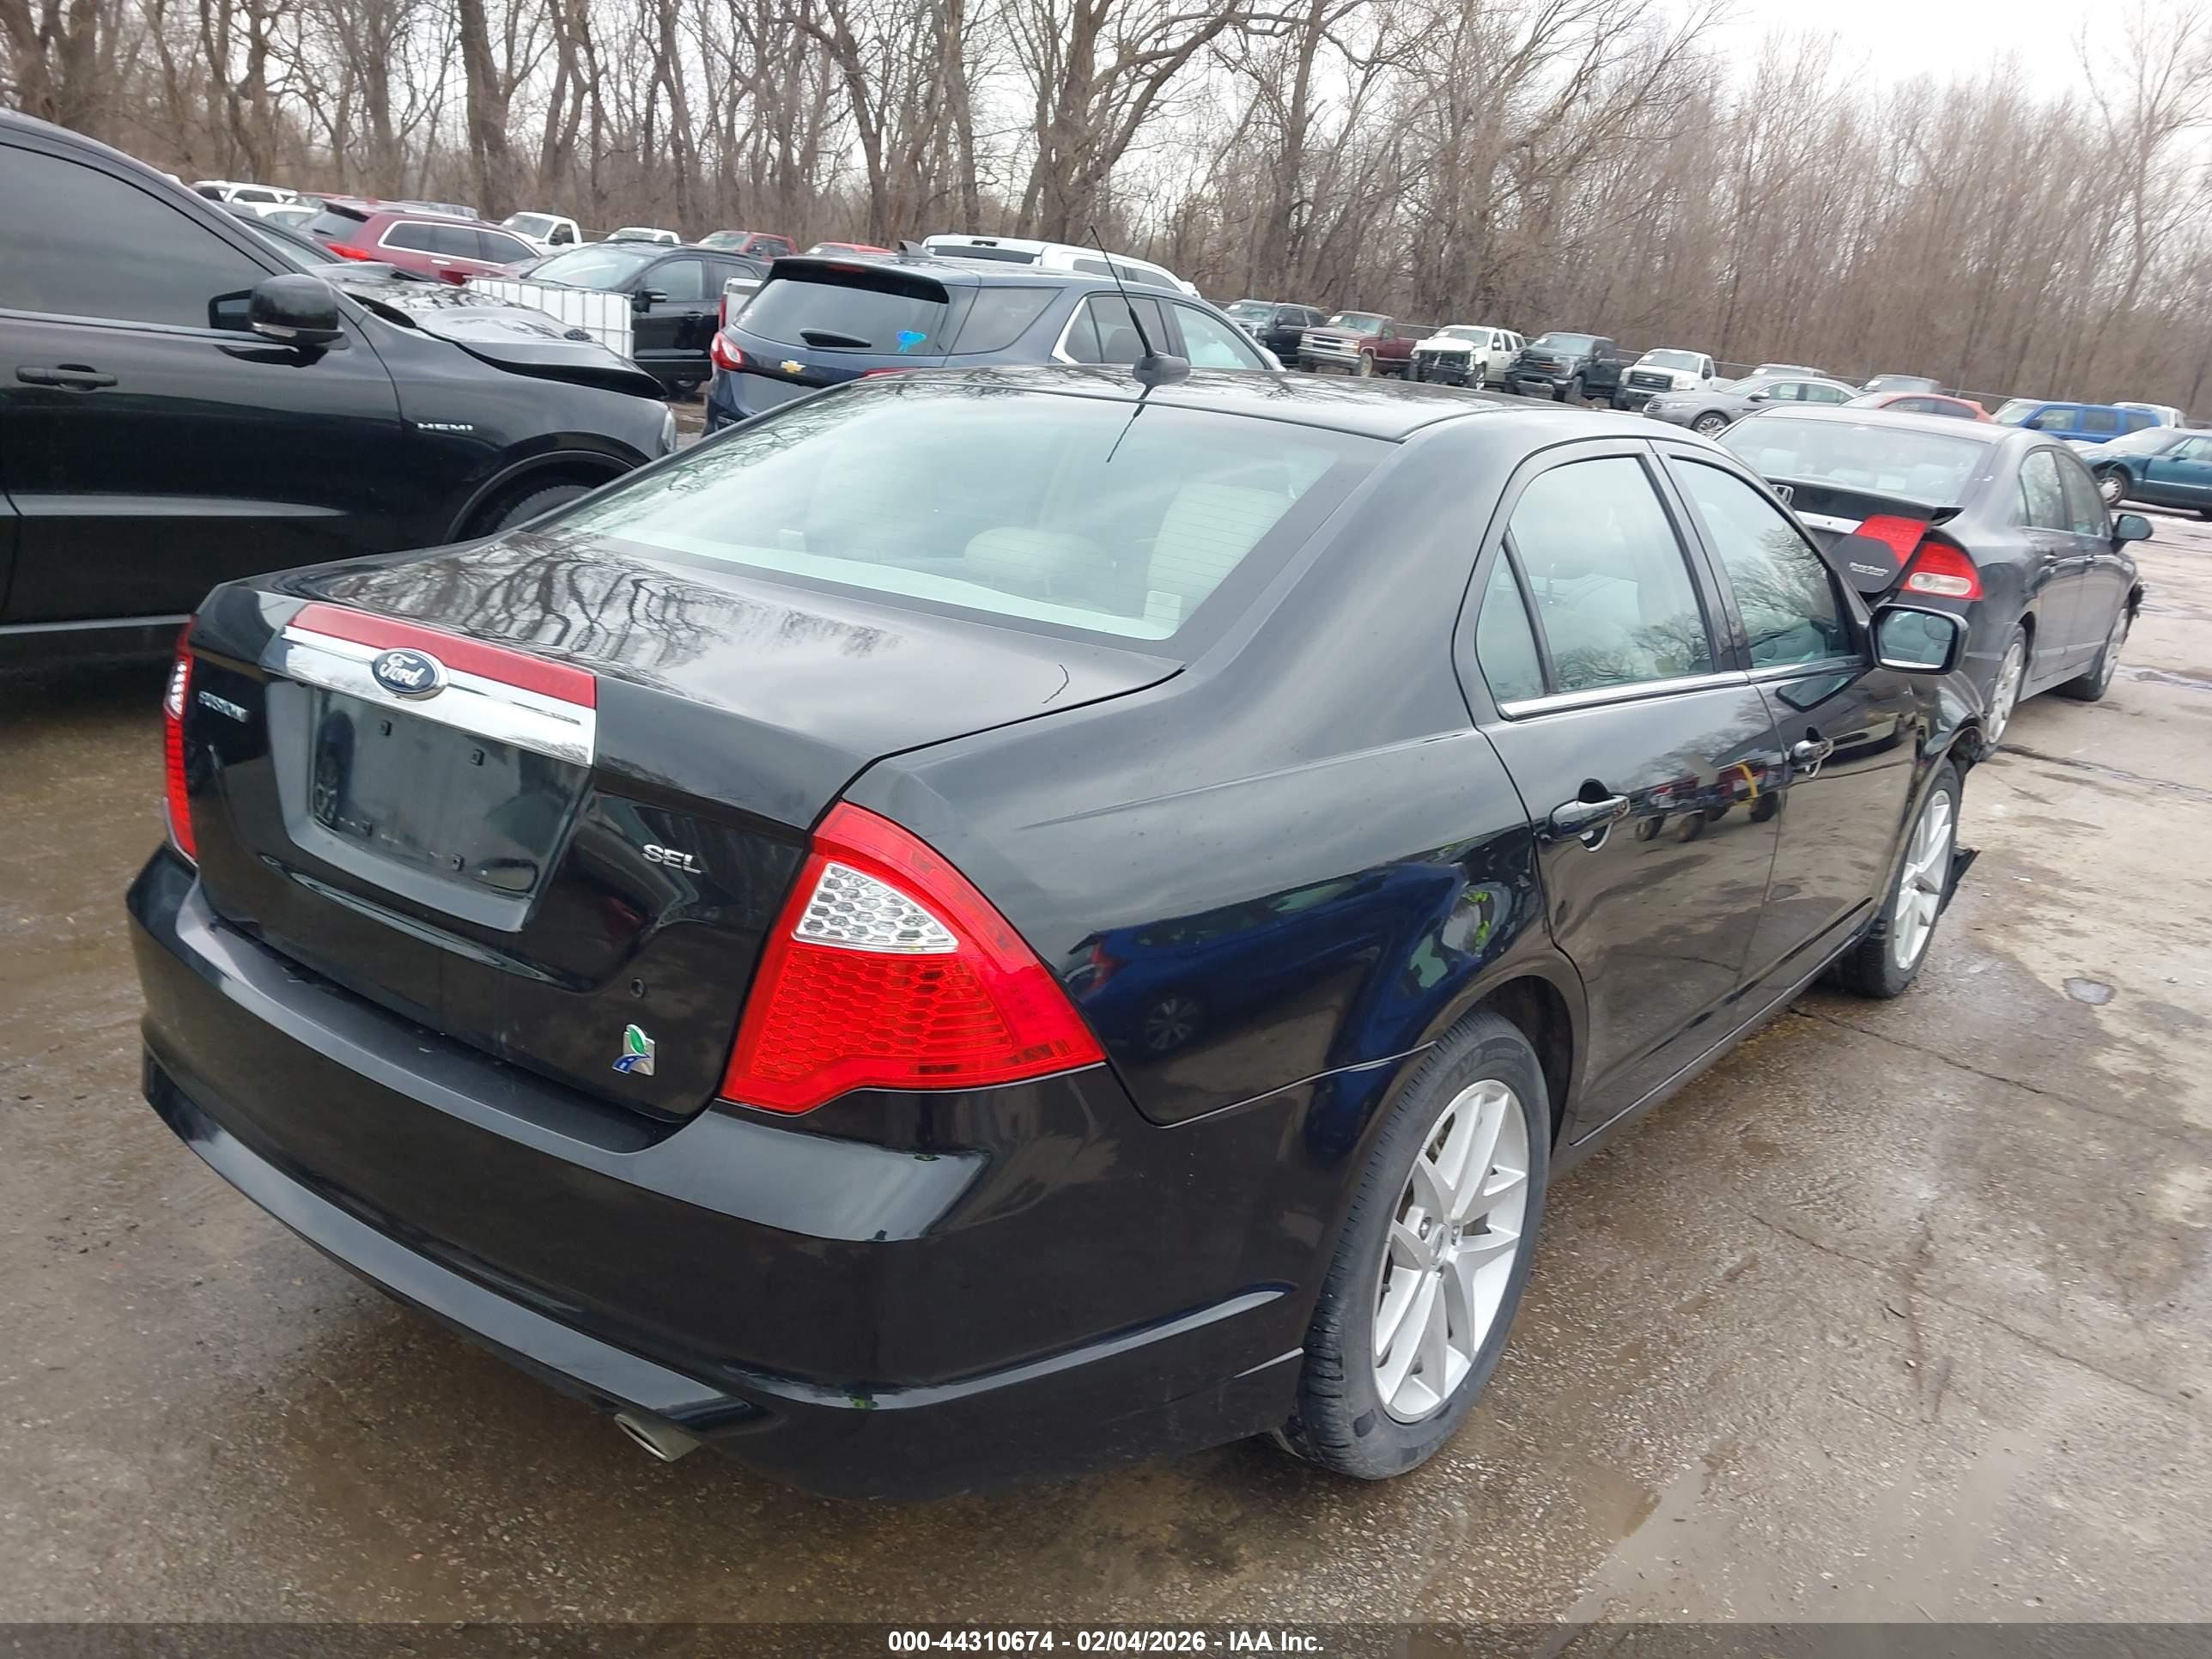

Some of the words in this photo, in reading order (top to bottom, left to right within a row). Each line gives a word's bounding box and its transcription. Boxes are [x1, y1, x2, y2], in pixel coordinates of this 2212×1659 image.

[416, 422, 474, 431] HEMI
[379, 653, 427, 686] Ford
[641, 844, 702, 875] SEL
